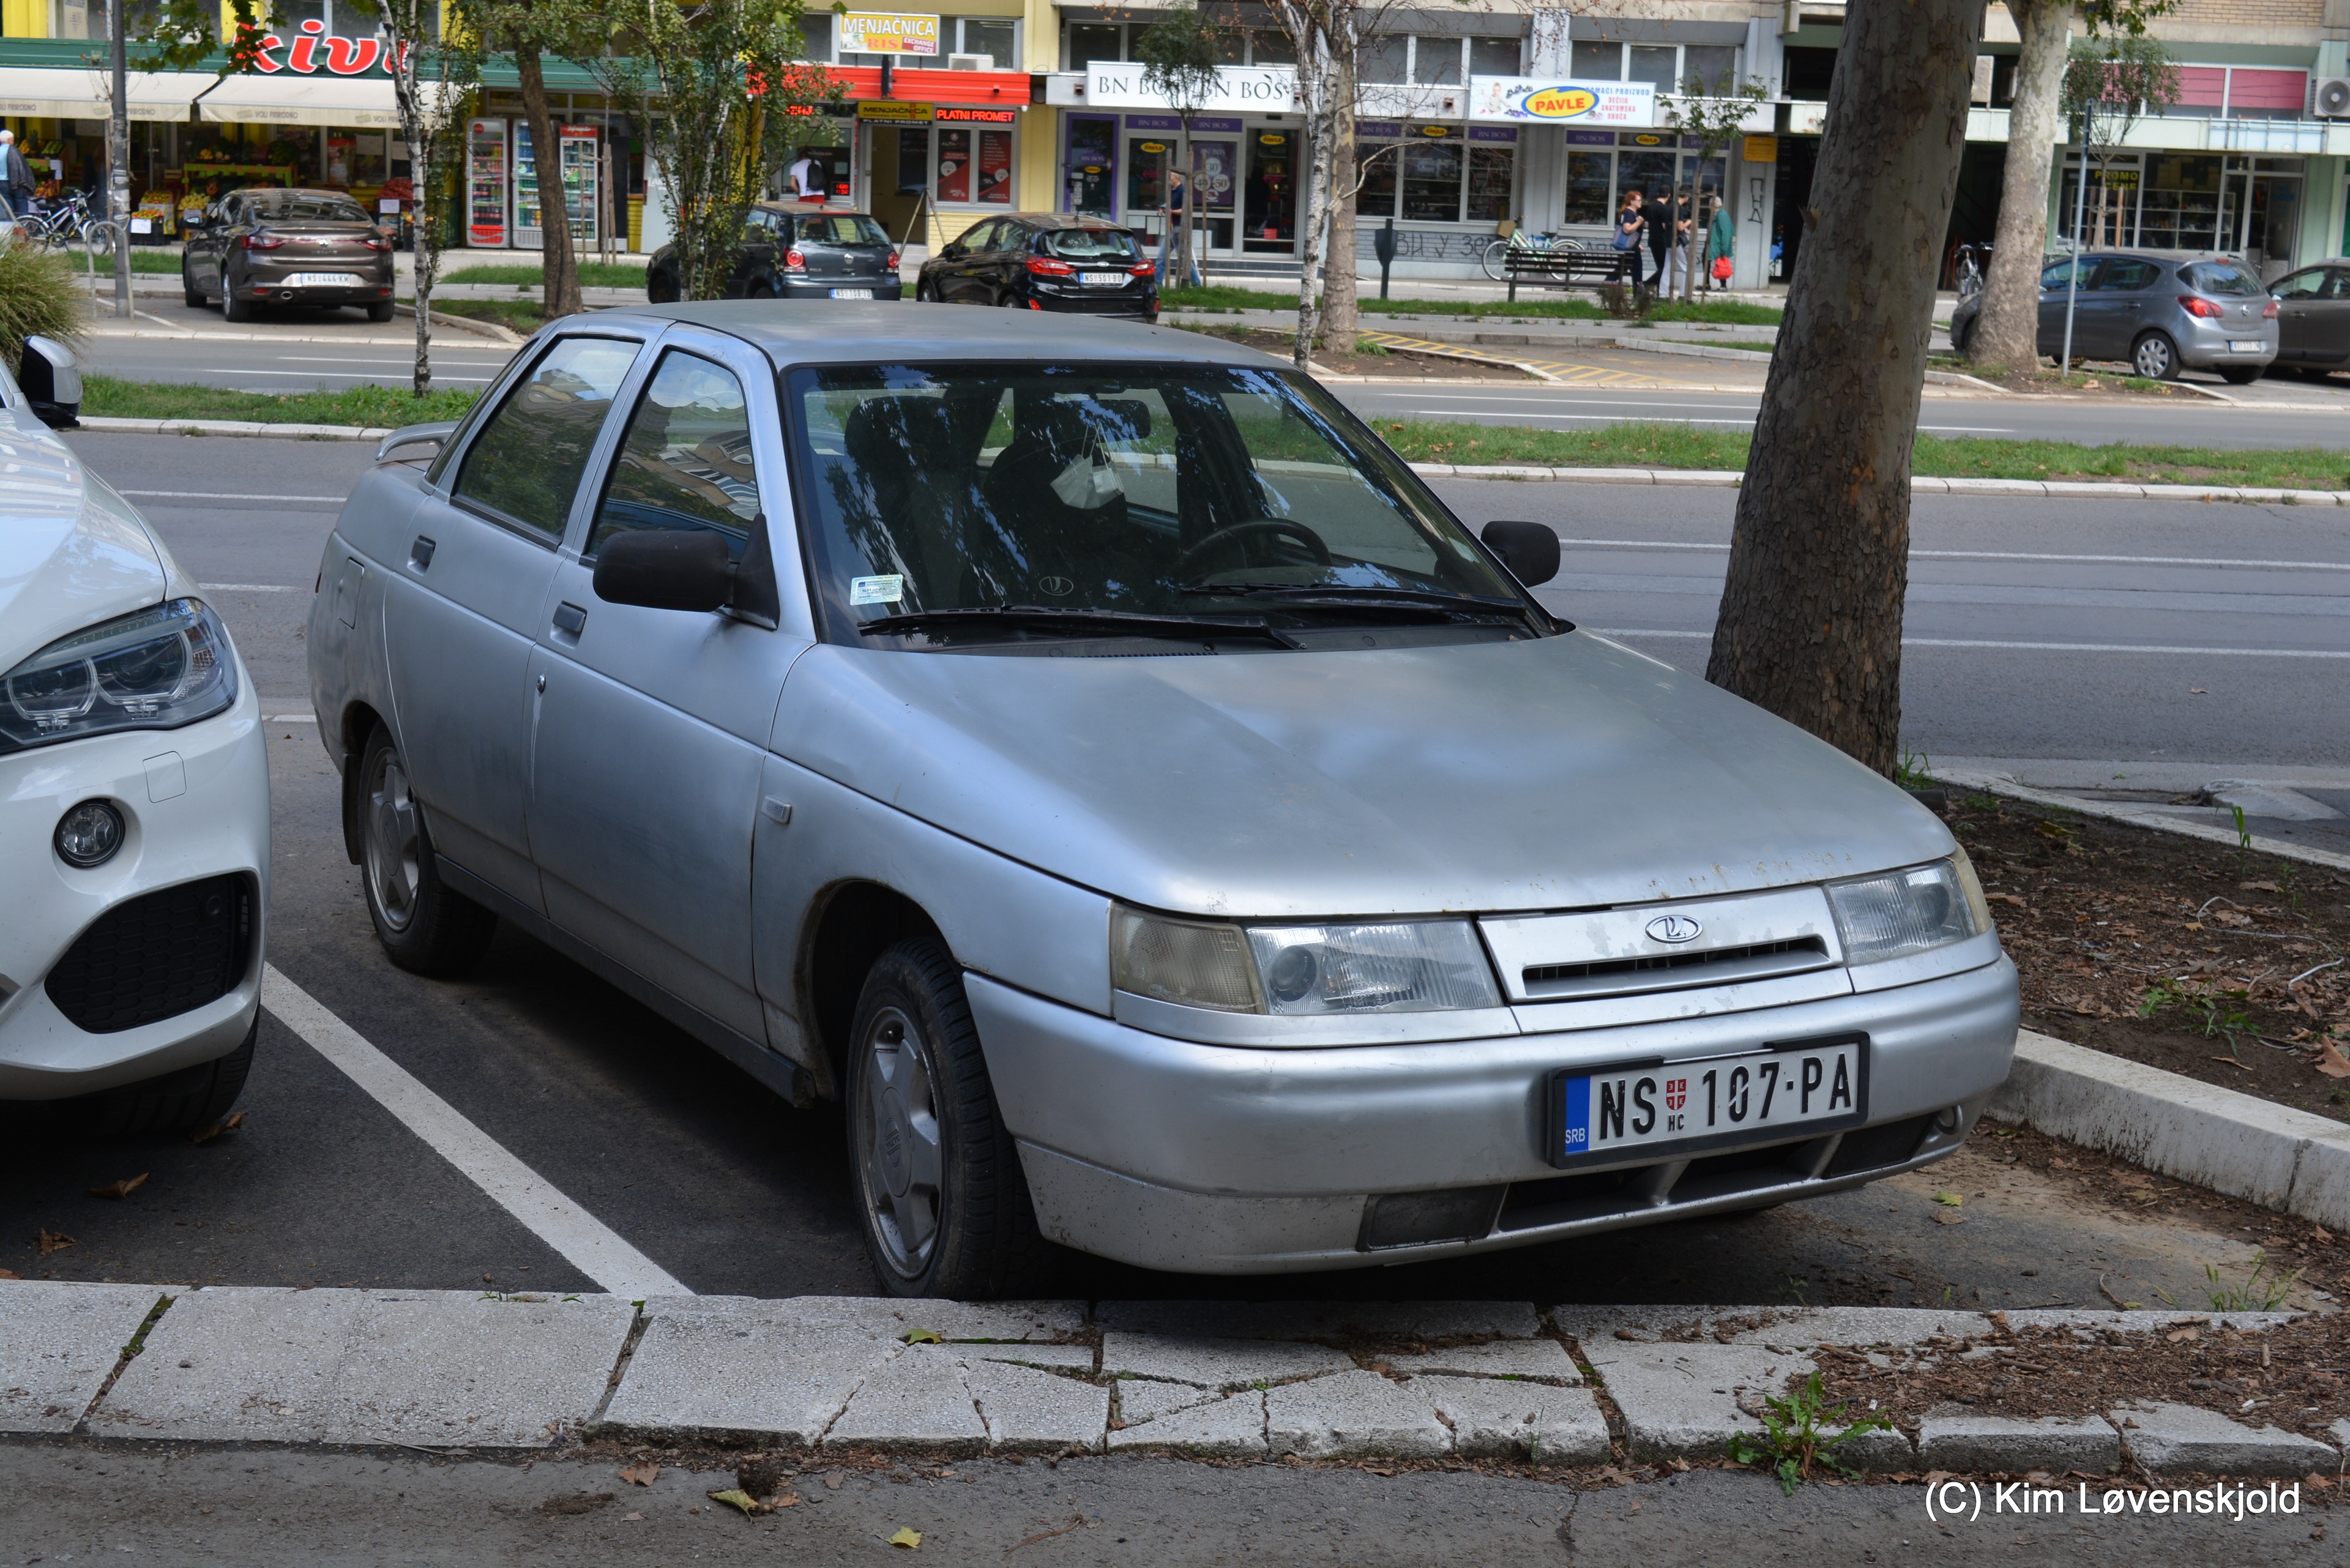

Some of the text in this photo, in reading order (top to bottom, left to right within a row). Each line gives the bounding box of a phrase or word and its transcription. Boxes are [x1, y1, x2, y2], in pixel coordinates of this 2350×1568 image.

[843, 16, 934, 36] MENJAČNICA
[867, 39, 898, 49] RIS
[903, 37, 934, 47] EXCHANGE
[912, 45, 934, 54] OFFICE
[1099, 77, 1129, 94] BN
[1535, 97, 1585, 112] PAVLE
[937, 110, 1015, 121] PLATNI PROMET
[2095, 171, 2139, 181] PROMO
[1599, 1077, 1657, 1140] NS
[1565, 1127, 1586, 1144] SRB
